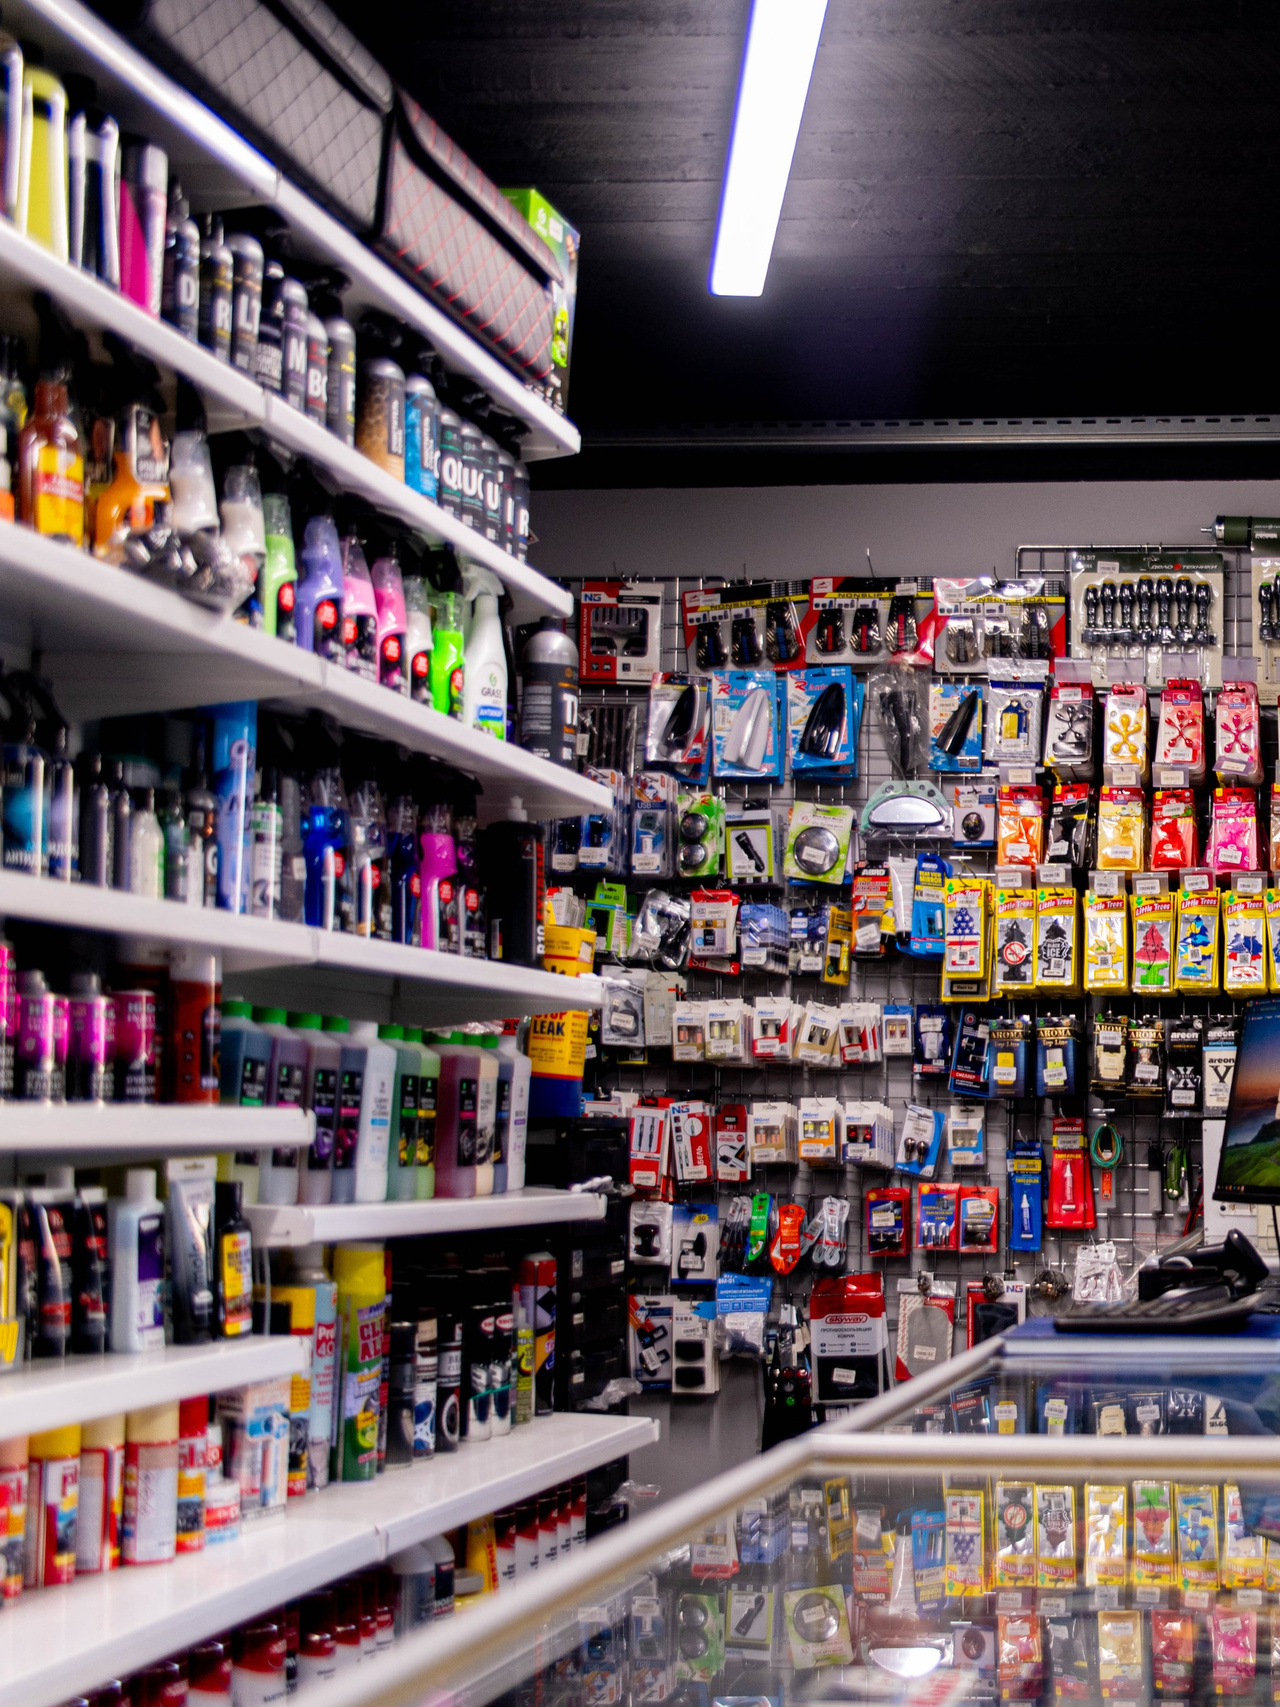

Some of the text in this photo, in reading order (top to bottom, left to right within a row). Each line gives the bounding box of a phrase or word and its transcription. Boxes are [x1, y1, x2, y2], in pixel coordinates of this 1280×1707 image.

[709, 600, 756, 610] NONSLIP
[637, 801, 652, 809] USB
[861, 868, 886, 876] ABRO
[998, 900, 1033, 913] Little Trees
[1038, 898, 1073, 911] Little Trees
[1181, 897, 1217, 909] Little Trees
[1227, 901, 1263, 915] Little Trees
[1135, 902, 1170, 916] Little Trees
[1045, 947, 1062, 958] ICE
[533, 1019, 565, 1036] LEAK
[1039, 1028, 1072, 1037] AROMA
[991, 1031, 1024, 1040] AROMA
[1129, 1031, 1163, 1039] AROMA
[1170, 1031, 1199, 1039] areon
[671, 1104, 691, 1115] NG
[1006, 1284, 1024, 1293] NG
[827, 1315, 866, 1324] skyway
